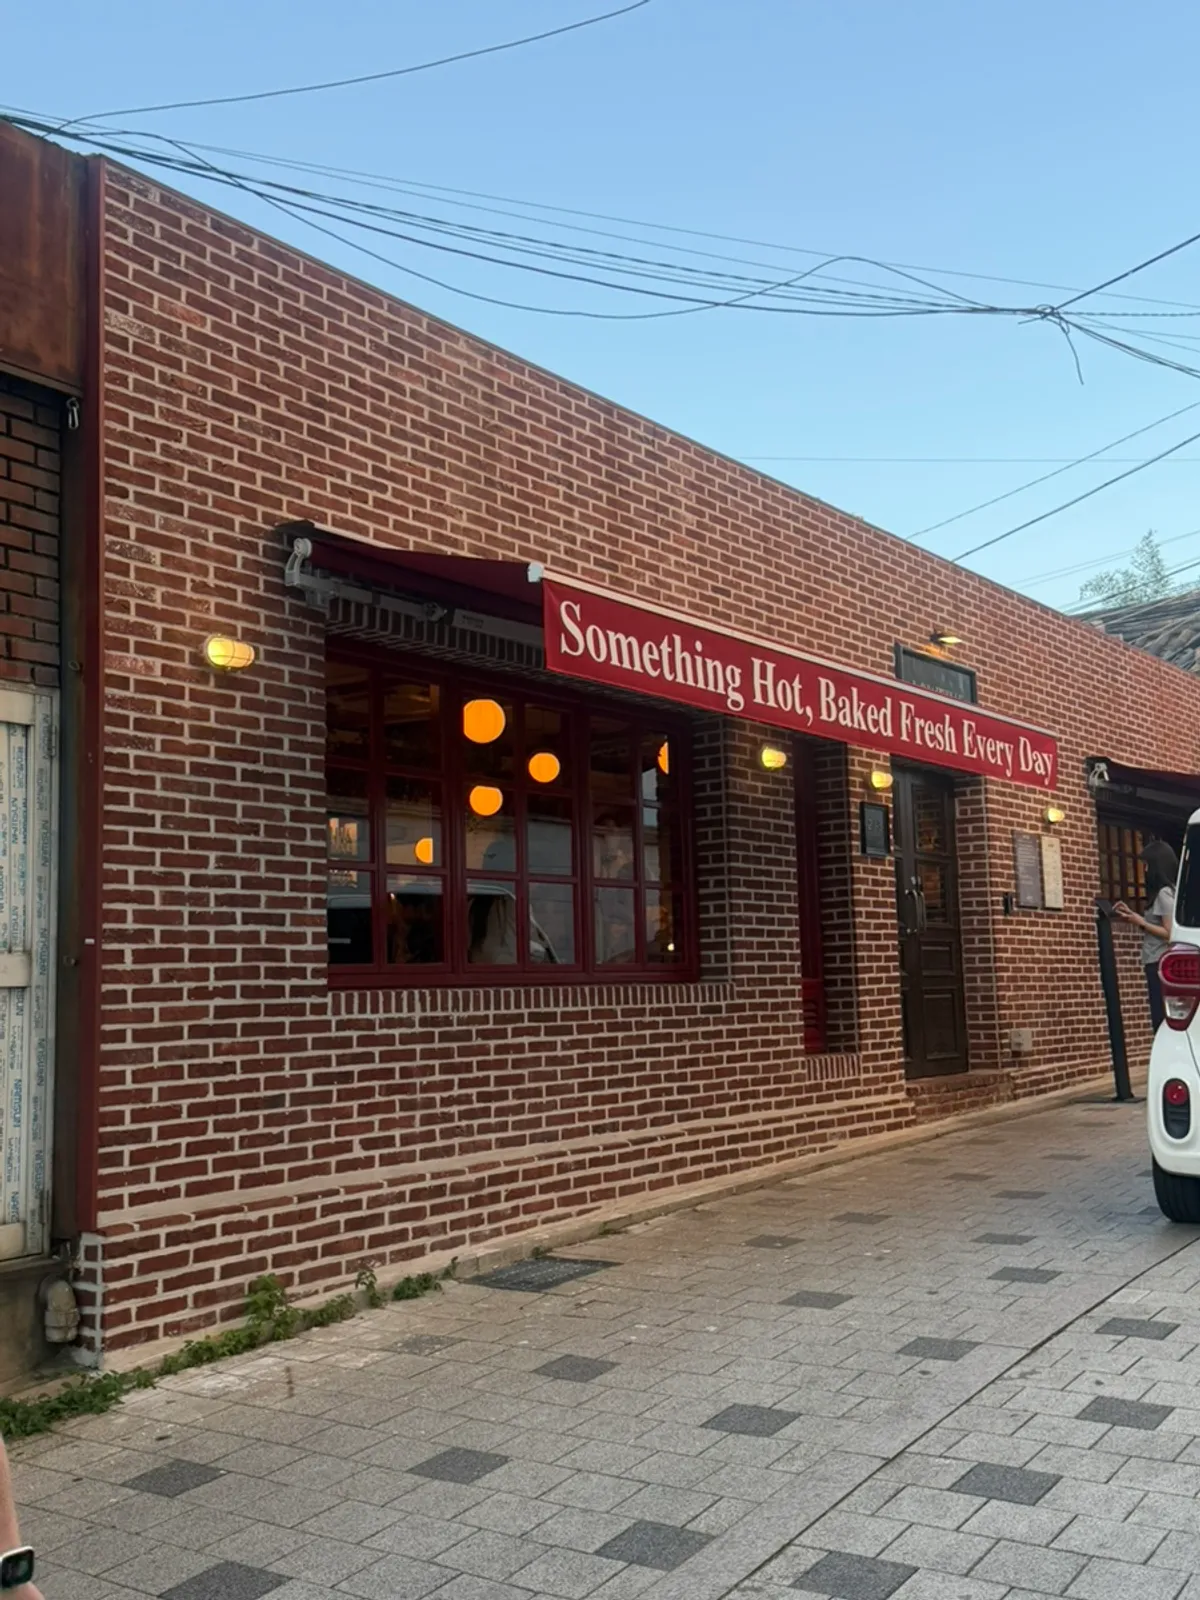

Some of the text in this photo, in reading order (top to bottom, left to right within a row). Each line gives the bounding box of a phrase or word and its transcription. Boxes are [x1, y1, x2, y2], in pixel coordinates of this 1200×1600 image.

[560, 601, 1054, 786] Something Hot, Baked Fresh Every Day
